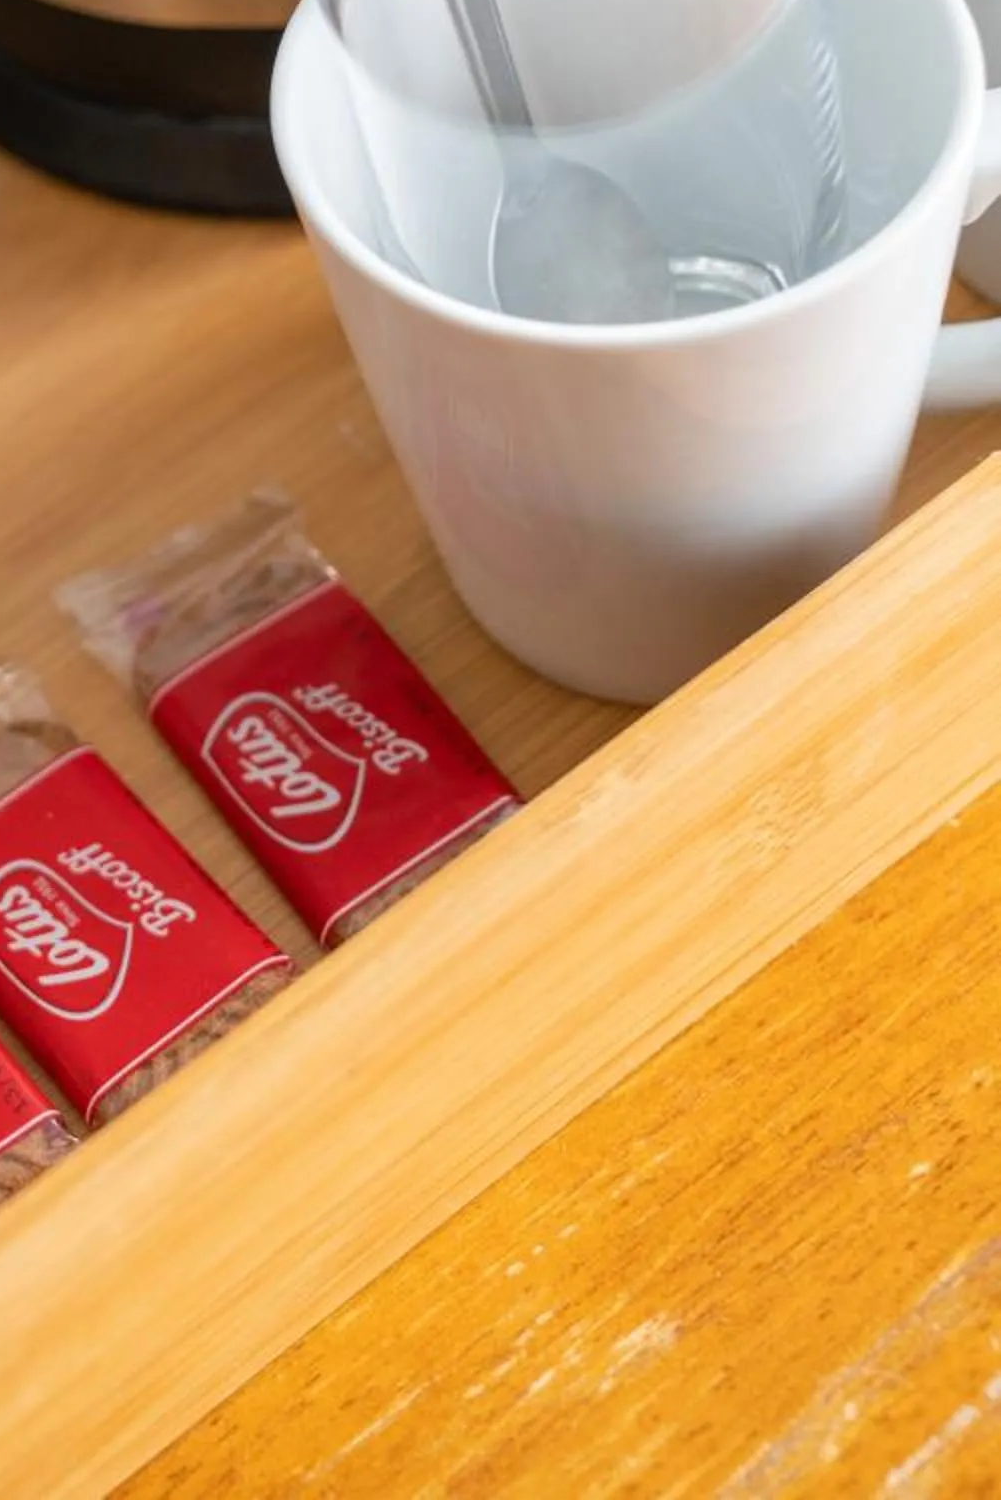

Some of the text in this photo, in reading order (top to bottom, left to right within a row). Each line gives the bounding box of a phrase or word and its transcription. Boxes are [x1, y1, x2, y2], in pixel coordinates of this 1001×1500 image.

[227, 716, 341, 819] Lotus
[292, 682, 429, 776] Biscoff
[57, 842, 196, 937] Biscoff
